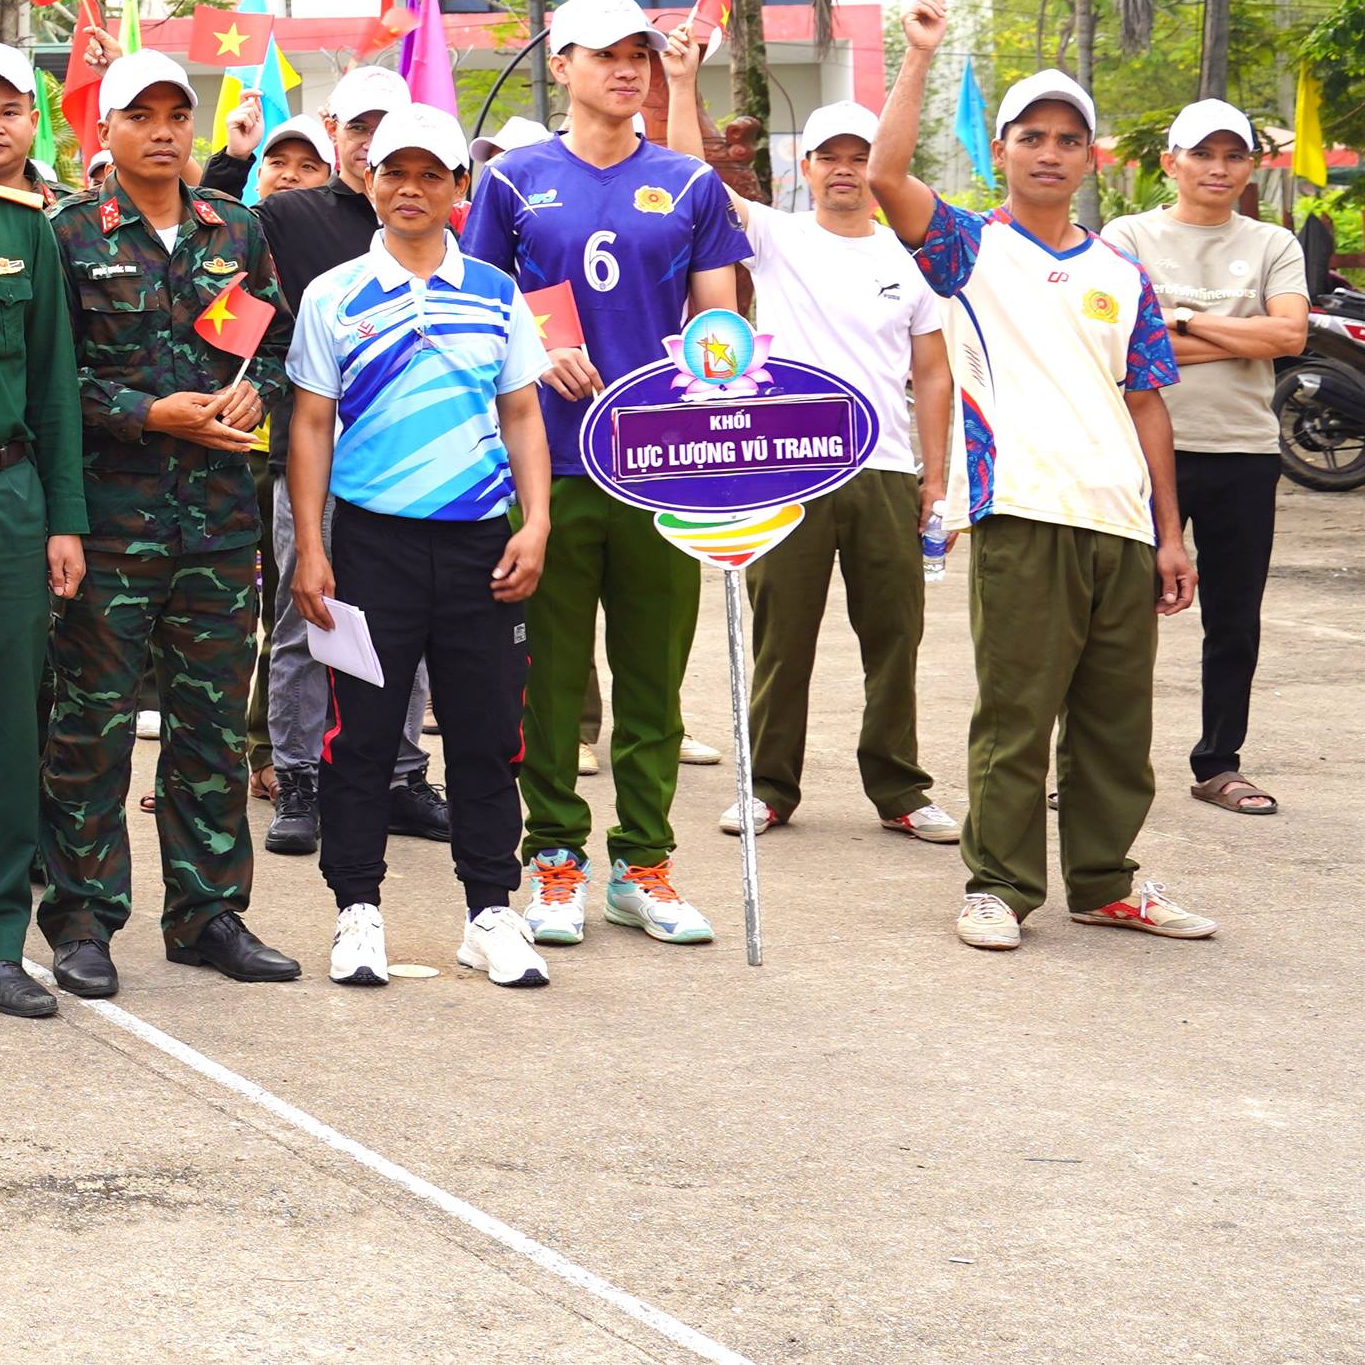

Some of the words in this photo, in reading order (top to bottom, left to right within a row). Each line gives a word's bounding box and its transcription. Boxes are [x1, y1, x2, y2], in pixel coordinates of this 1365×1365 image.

[584, 230, 620, 292] 6
[710, 409, 751, 431] KHỐI
[627, 444, 663, 473] LỰC
[669, 440, 736, 470] LƯỢNG
[742, 435, 768, 461] VŨ
[773, 435, 844, 459] TRANG
